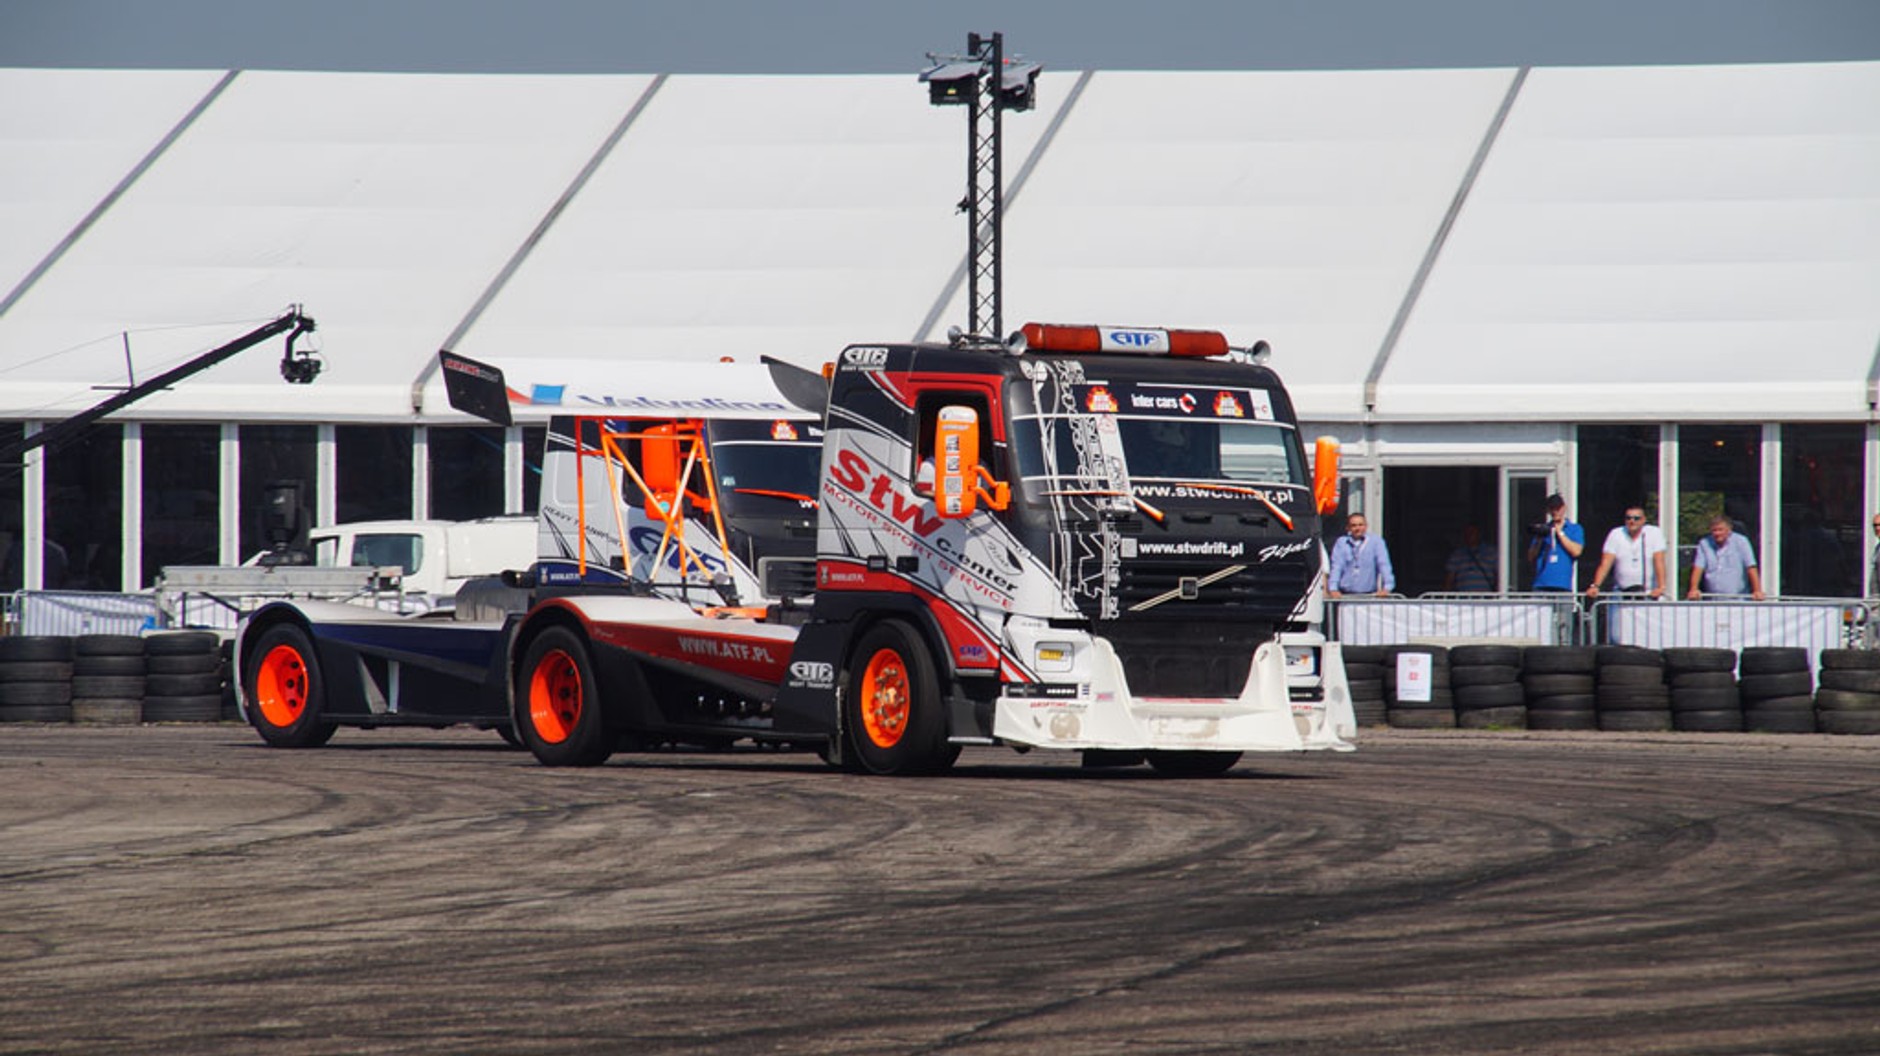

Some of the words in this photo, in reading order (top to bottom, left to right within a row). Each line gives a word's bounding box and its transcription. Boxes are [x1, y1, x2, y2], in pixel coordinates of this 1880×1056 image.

[577, 394, 787, 410] Valvoline
[830, 448, 944, 538] Stw
[824, 482, 878, 525] MOTOR
[882, 521, 934, 560] SPORT
[937, 560, 1014, 609] SERVICE
[1139, 541, 1244, 557] www.stwdrift.pl
[677, 636, 775, 664] WWW.ATF.PL
